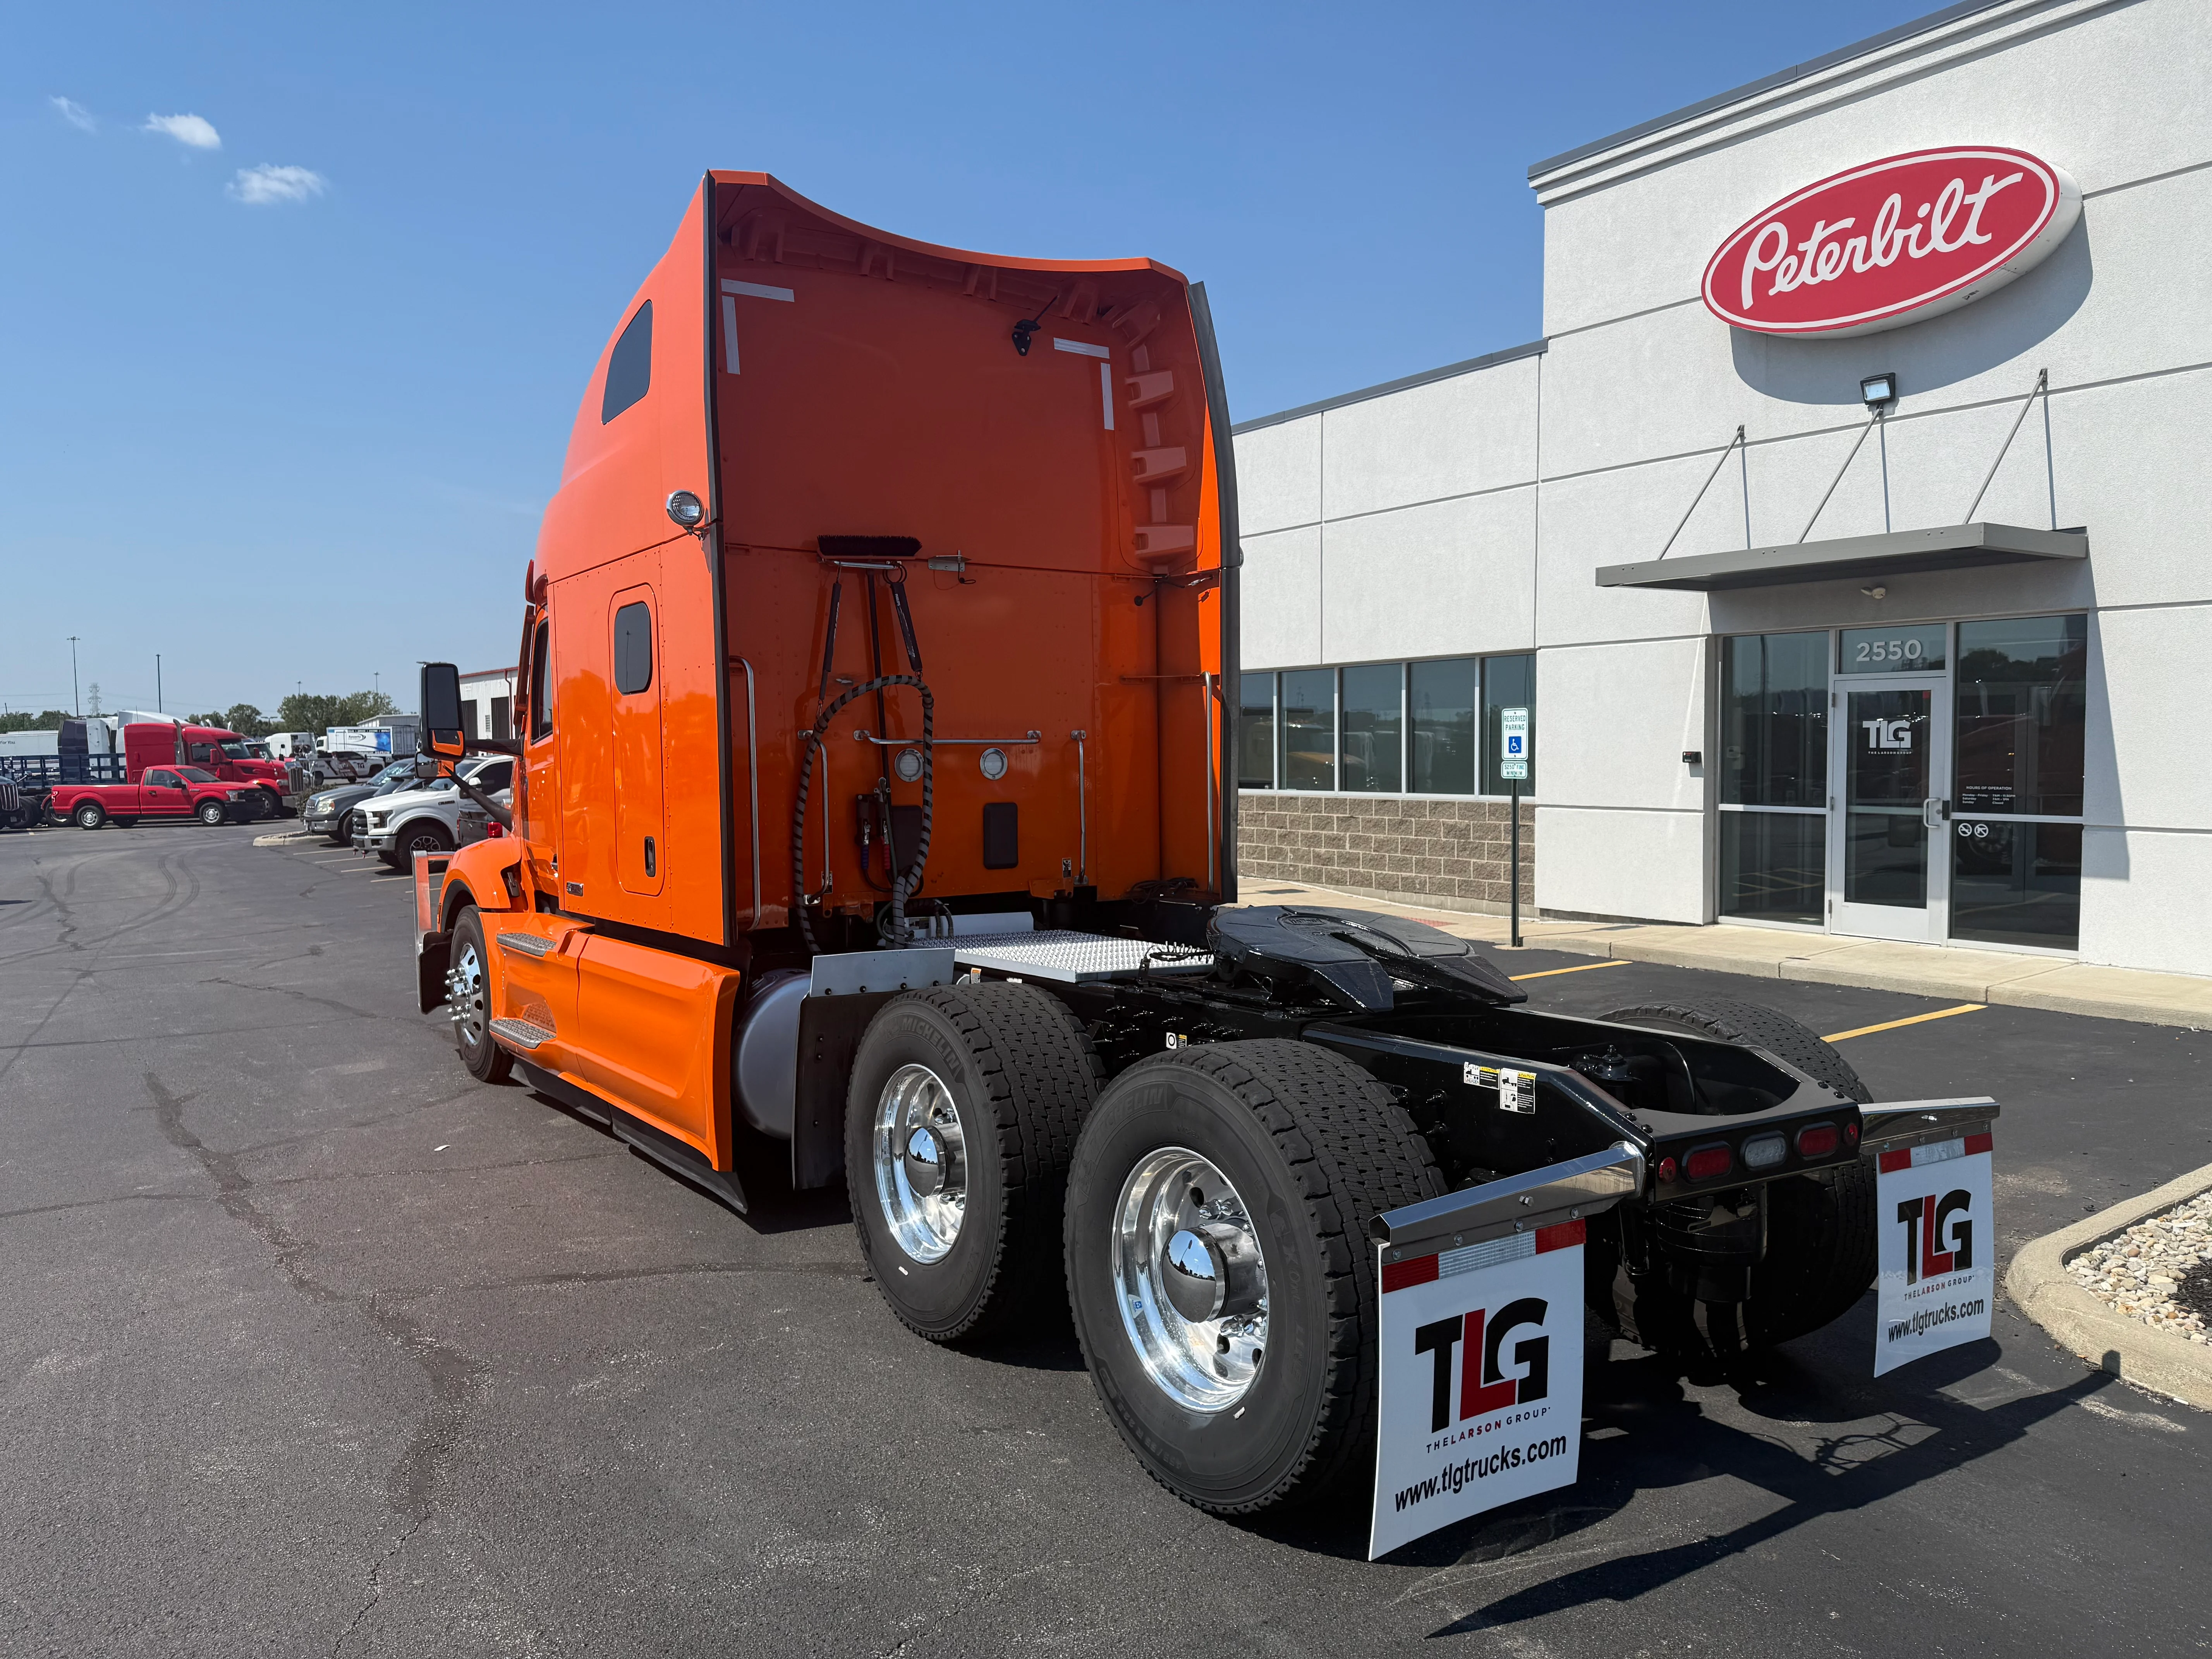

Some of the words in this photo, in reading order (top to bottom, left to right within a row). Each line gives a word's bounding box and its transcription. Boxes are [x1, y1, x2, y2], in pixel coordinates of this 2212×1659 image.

[1742, 173, 2023, 309] Peterbilt
[1856, 639, 1922, 661] 2550
[1863, 720, 1911, 748] TLG
[902, 1017, 960, 1070] MICHELIN
[1090, 1086, 1164, 1150] MICHELIN
[1898, 1189, 1972, 1286] TLG
[1948, 1276, 1972, 1287] GROUP
[1888, 1298, 1984, 1343] www.tlgtrucks.com
[1415, 1297, 1549, 1434] TLG
[1506, 1407, 1547, 1425] GROUP
[1395, 1436, 1566, 1512] www.tlgtrucks.com
